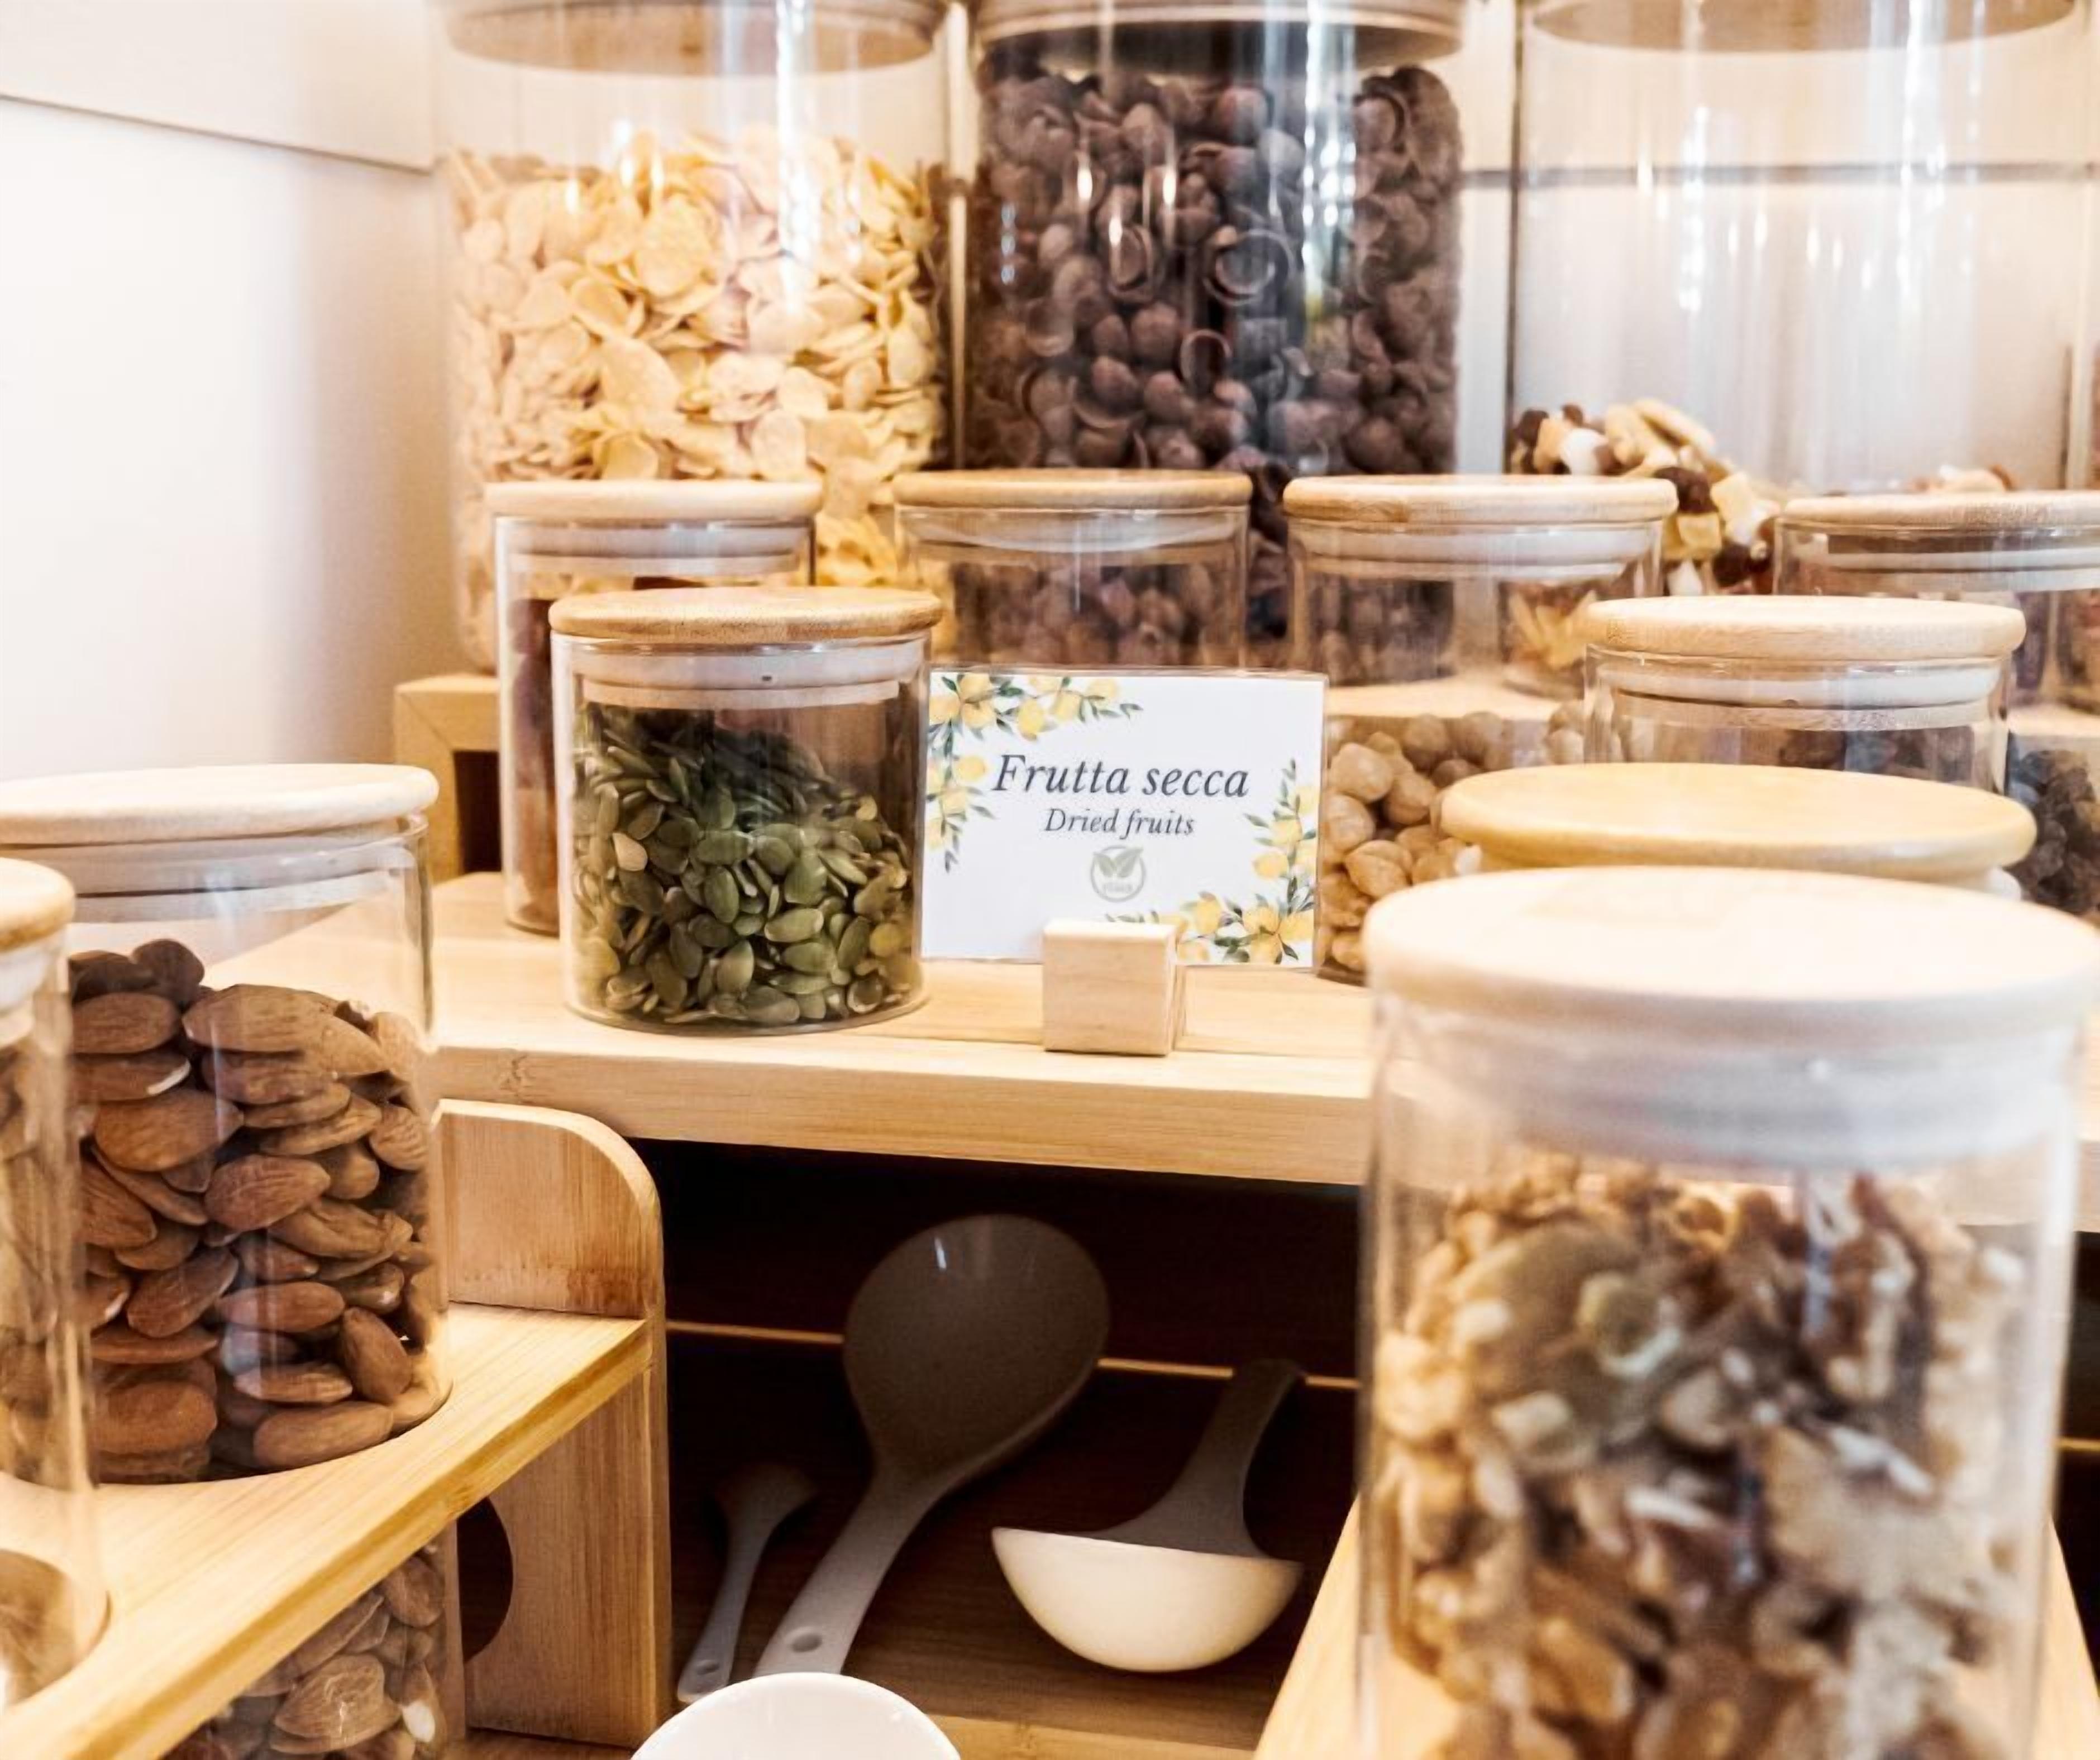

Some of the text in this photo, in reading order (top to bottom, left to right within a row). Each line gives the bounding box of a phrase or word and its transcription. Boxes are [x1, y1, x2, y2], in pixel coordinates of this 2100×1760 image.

[991, 754, 1249, 798] Frutta secca
[1044, 807, 1195, 840] Dried fruits
